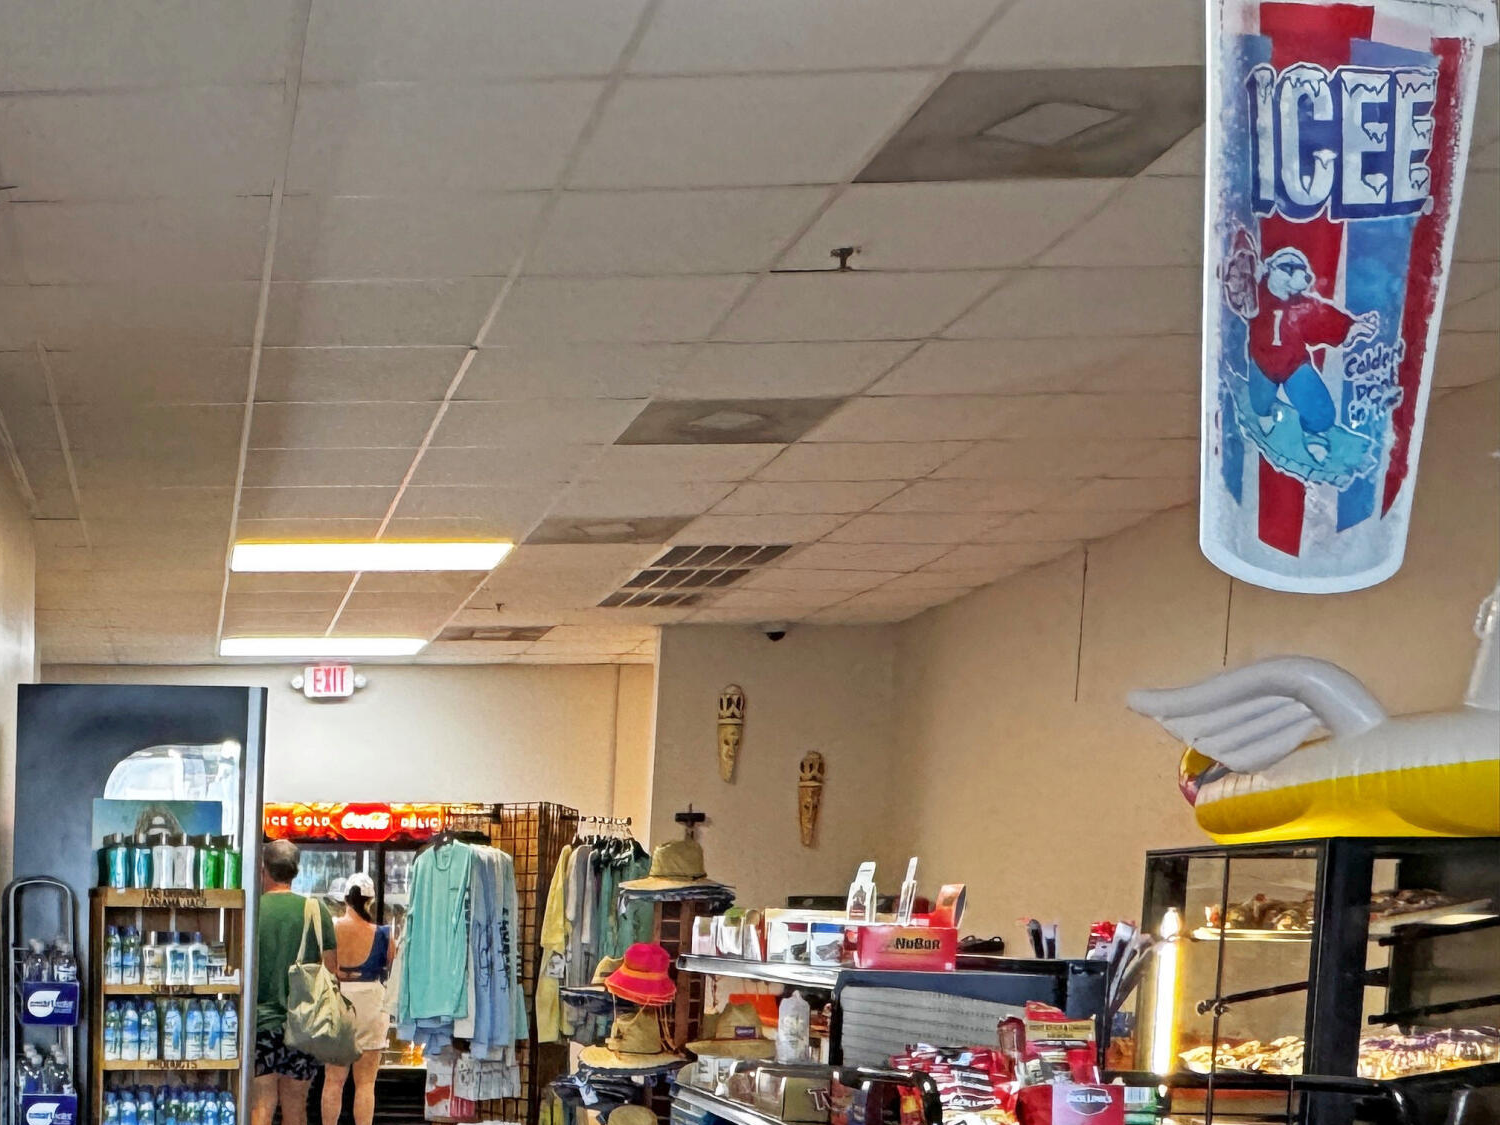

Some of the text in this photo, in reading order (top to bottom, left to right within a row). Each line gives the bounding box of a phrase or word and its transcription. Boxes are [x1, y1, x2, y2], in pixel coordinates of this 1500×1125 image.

[1249, 66, 1438, 221] ICEE
[313, 667, 347, 693] EXIT
[265, 816, 331, 827] ICE COLD
